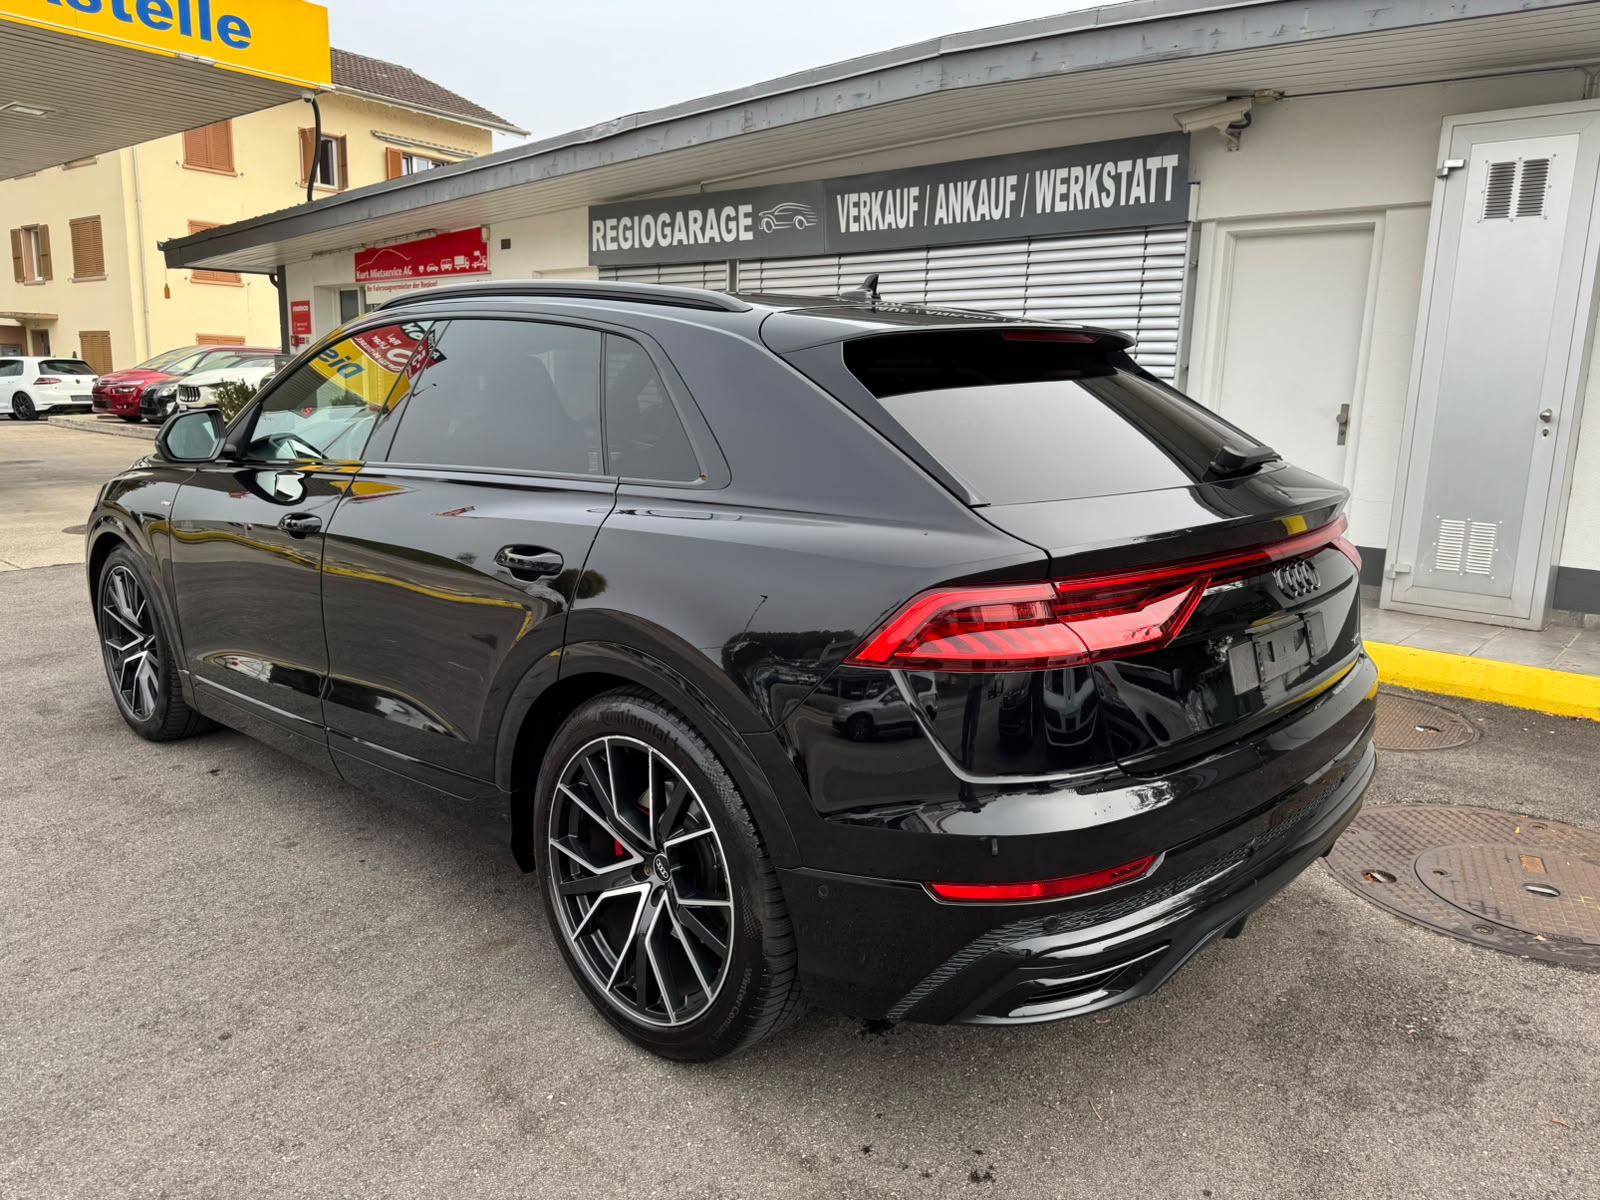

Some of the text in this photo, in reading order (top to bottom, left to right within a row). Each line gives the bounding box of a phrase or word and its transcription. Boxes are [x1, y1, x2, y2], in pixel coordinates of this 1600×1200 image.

[836, 154, 1179, 234] VERKAUF / ANKAUF / WERKSTATT
[592, 204, 754, 252] REGIOGARAGE
[356, 265, 412, 279] Kurt Mietservice AG
